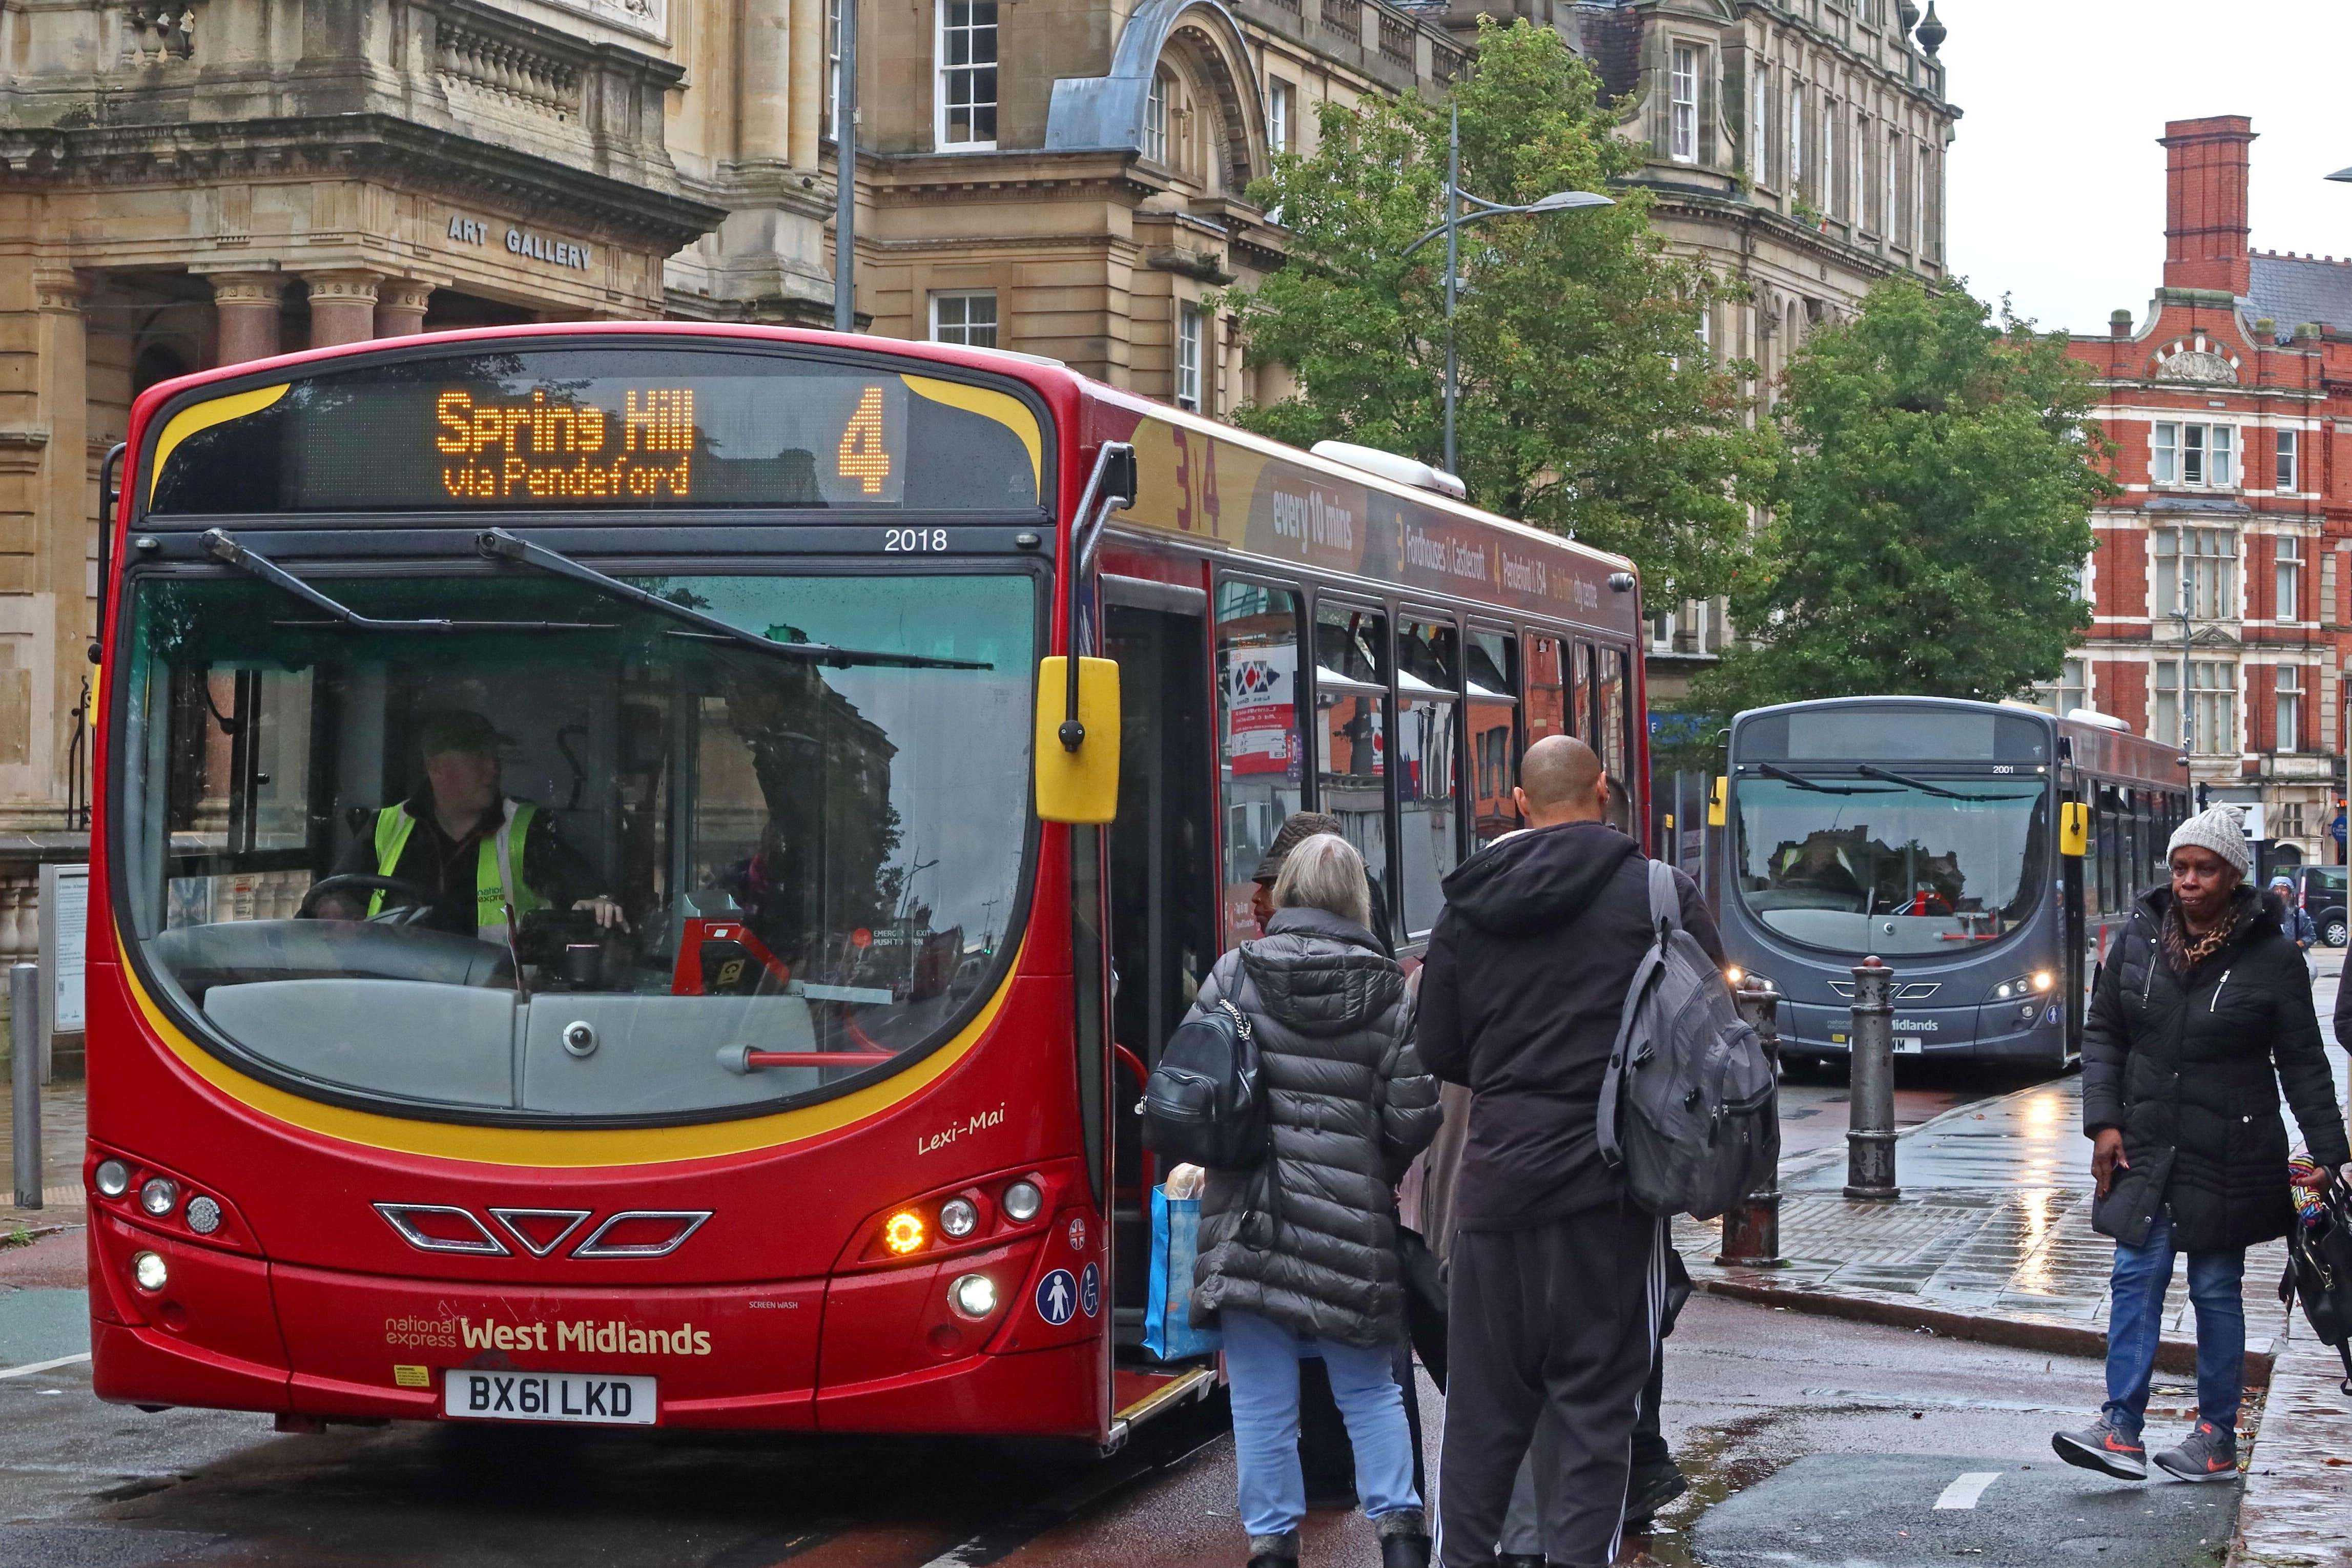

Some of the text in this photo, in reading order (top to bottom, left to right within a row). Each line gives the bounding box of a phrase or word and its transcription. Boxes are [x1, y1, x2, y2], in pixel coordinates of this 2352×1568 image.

[448, 216, 591, 270] ART GALLERY
[438, 390, 694, 453] Spring Hill
[839, 387, 889, 493] 4
[444, 456, 689, 496] via Pendeford
[1171, 425, 1220, 538] 3 4
[884, 529, 947, 551] 2018
[1273, 490, 1353, 554] every 10 mins
[1395, 513, 1404, 572] 3
[1406, 524, 1446, 572] Fordhouses
[1453, 538, 1486, 581] Castlecroft
[1503, 552, 1531, 592] Pendeford
[1993, 766, 2013, 774] 2001
[918, 1102, 1006, 1156] Lexi-Mai
[385, 1315, 456, 1333] national
[386, 1332, 457, 1349] express
[461, 1317, 712, 1355] West Midlands
[469, 1376, 631, 1417] BX61 LKD
